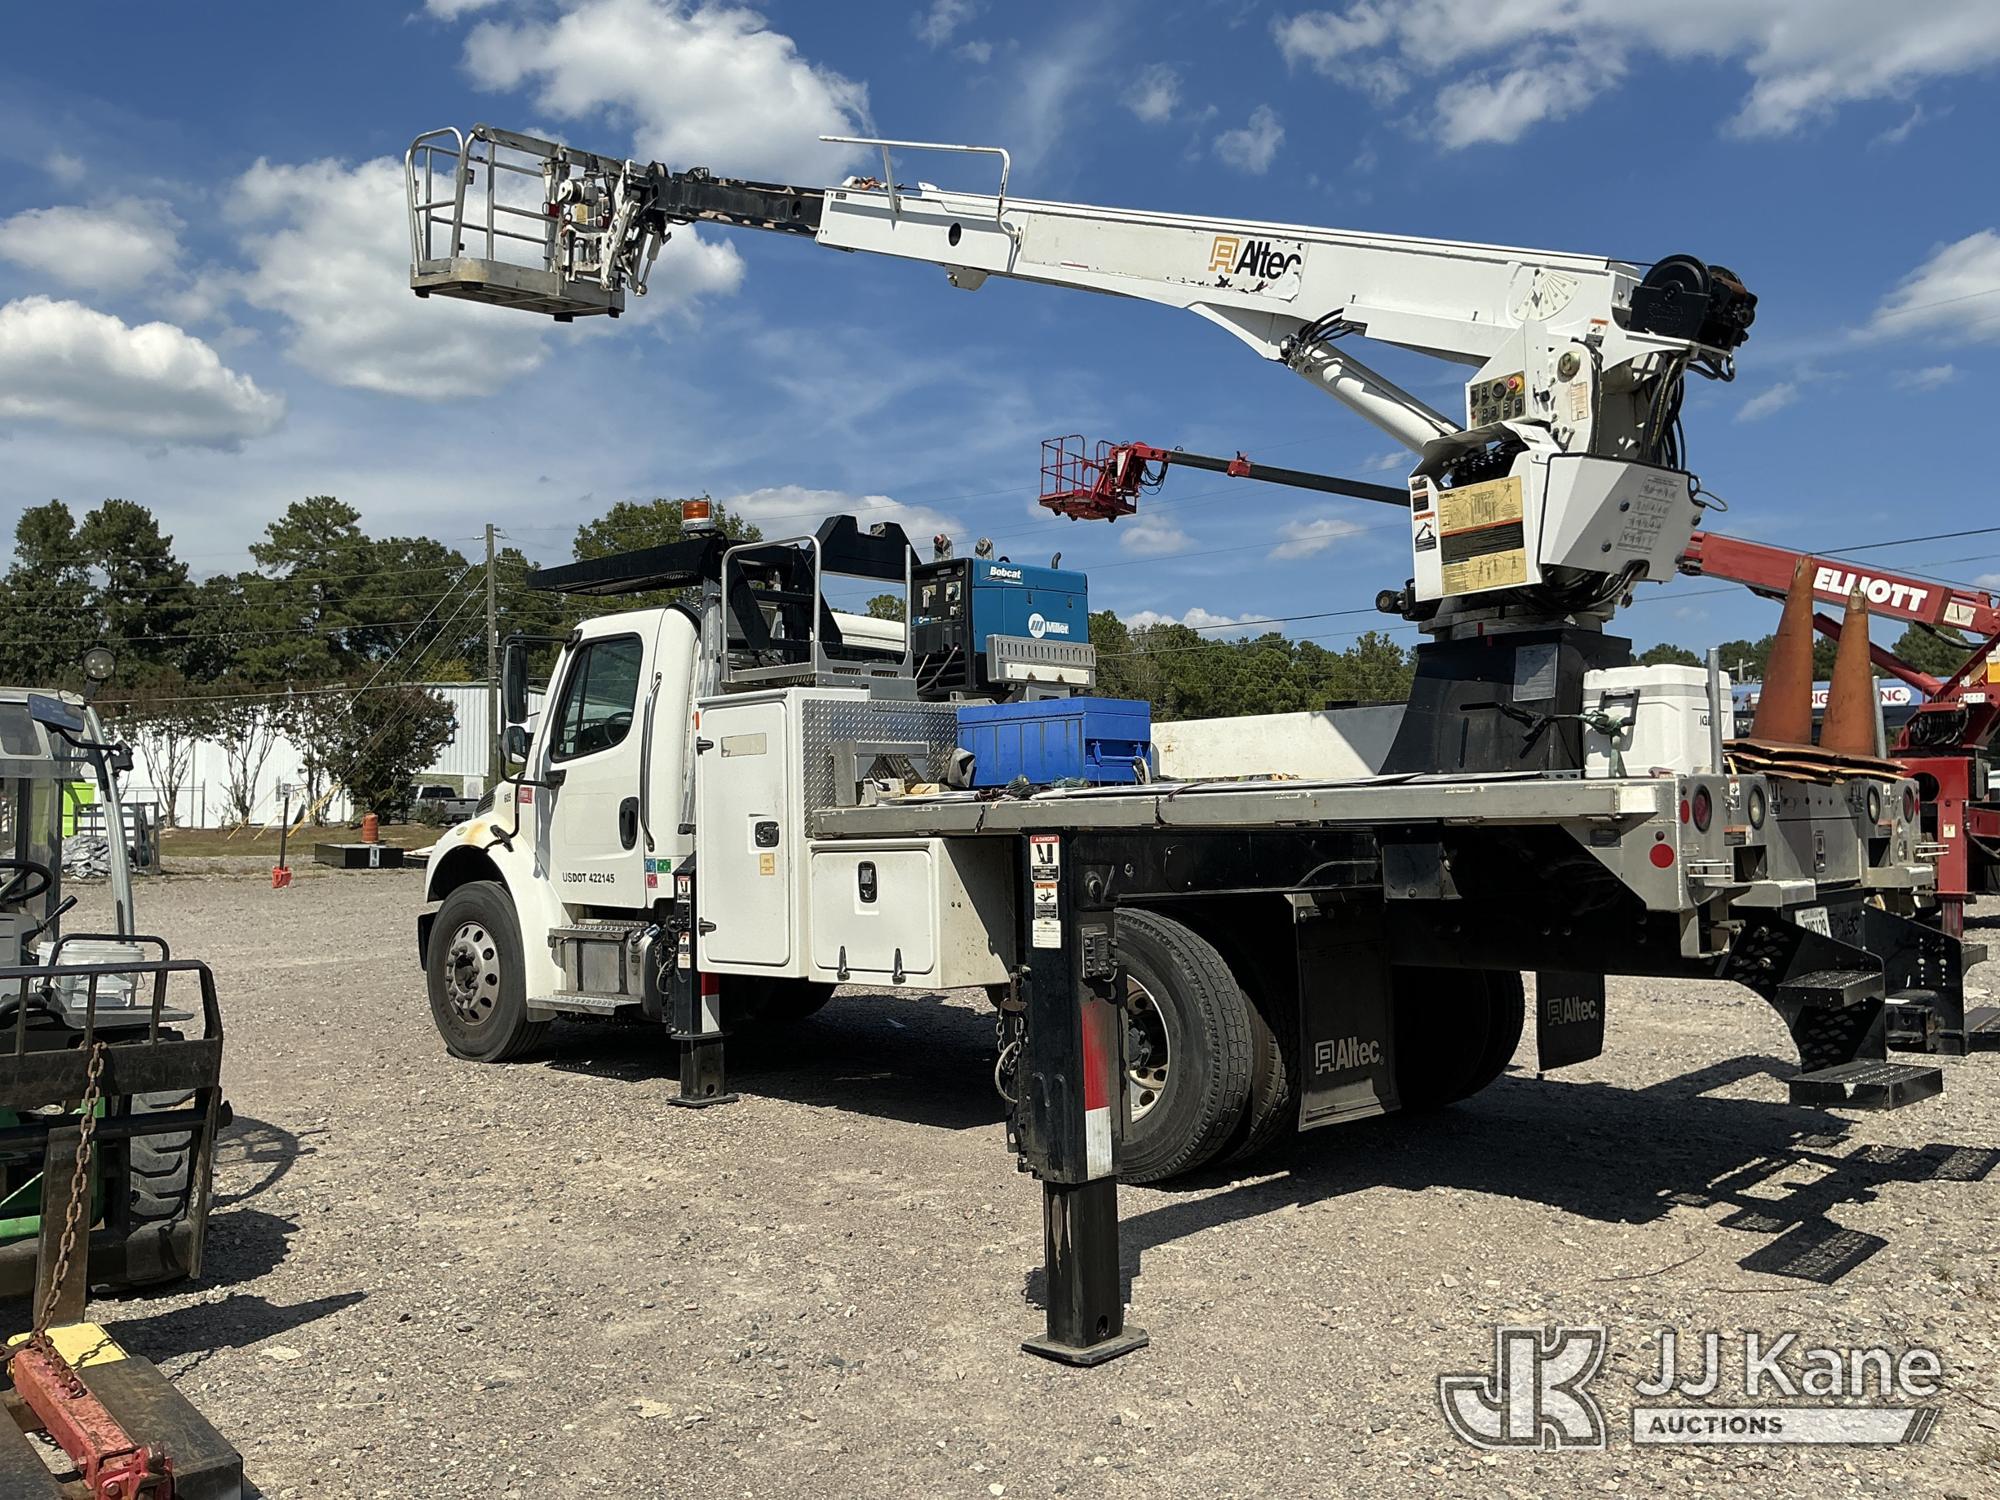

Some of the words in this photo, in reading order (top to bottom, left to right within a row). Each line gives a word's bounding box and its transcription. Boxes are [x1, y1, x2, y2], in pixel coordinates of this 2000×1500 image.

[1234, 240, 1302, 280] Altec
[989, 566, 1022, 579] Bobcat
[1046, 621, 1069, 634] Miller
[1879, 689, 1907, 702] NC.
[562, 872, 586, 883] USDOT
[588, 873, 615, 884] 422145
[1564, 996, 1596, 1024] Altec
[1335, 1036, 1380, 1071] Altec
